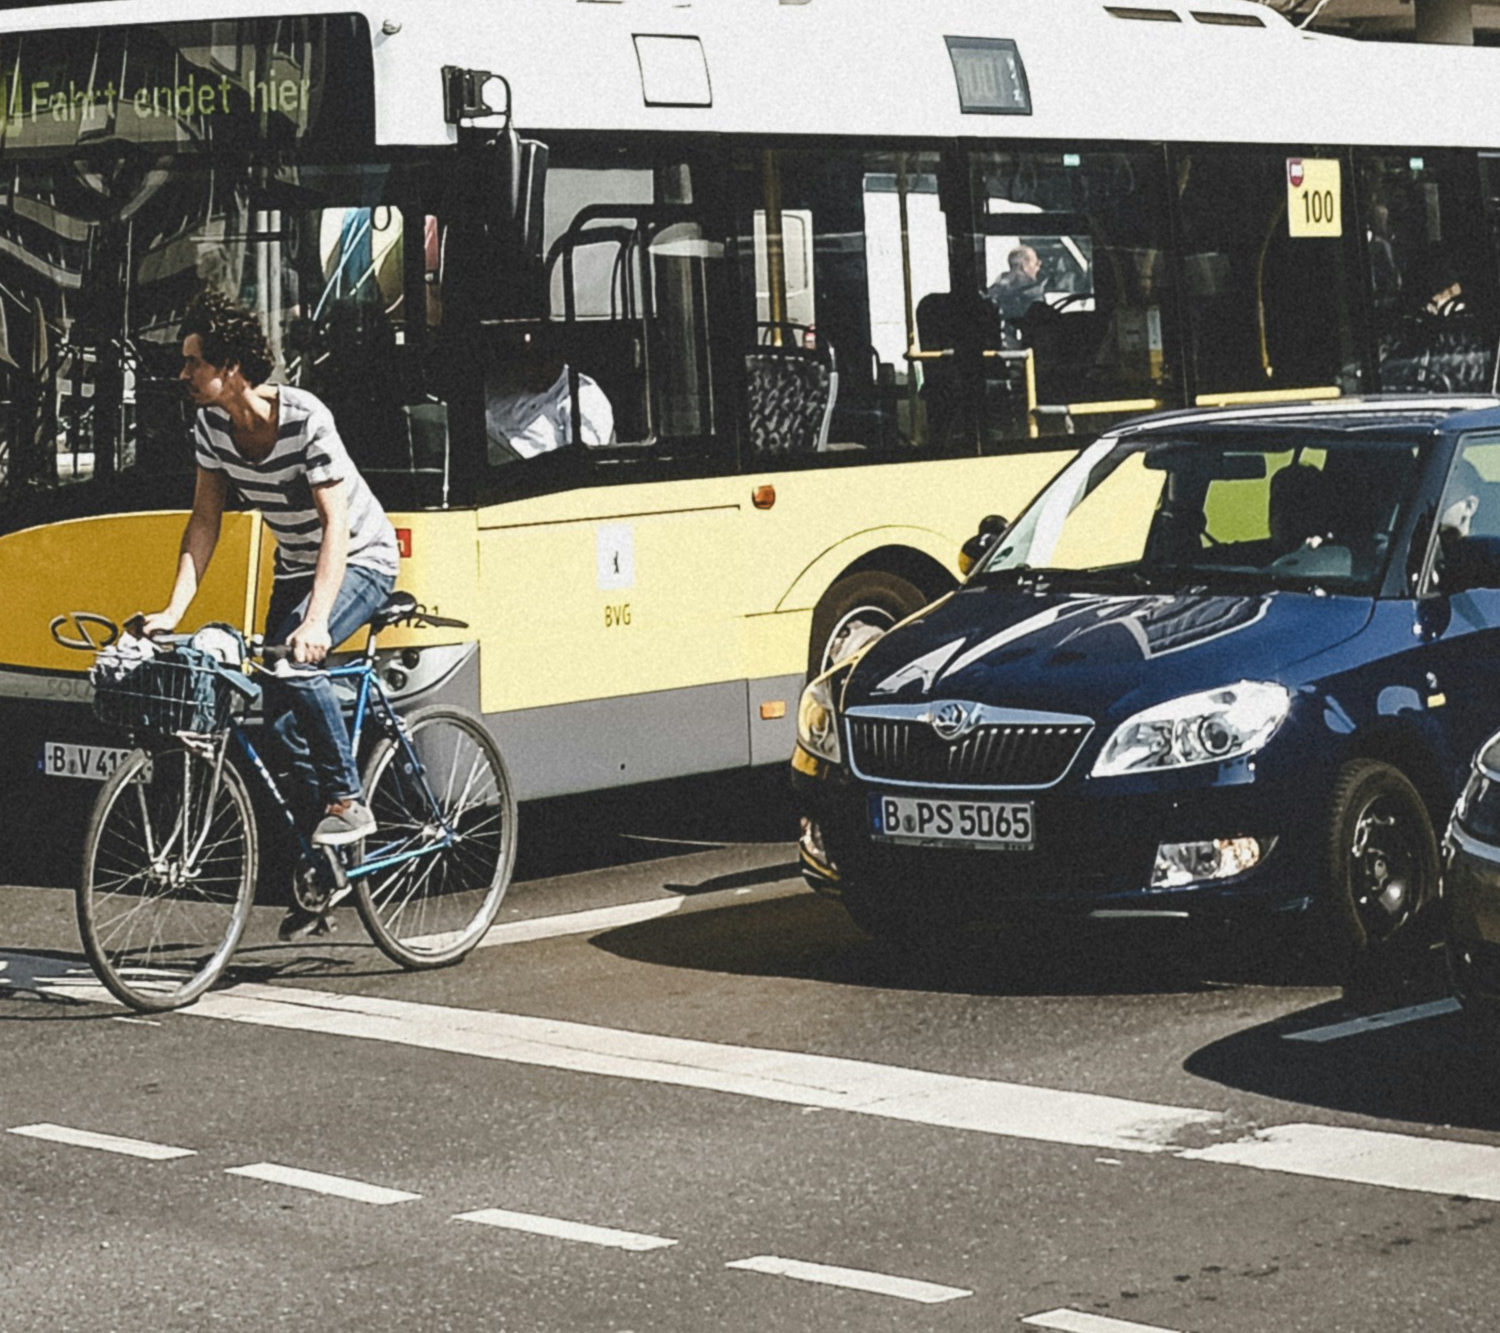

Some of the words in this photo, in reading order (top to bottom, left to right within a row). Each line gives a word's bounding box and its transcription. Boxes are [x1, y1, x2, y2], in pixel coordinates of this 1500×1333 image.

[133, 73, 230, 119] endet
[1302, 190, 1334, 223] 100
[604, 603, 631, 628] BVG
[53, 745, 66, 773] B
[78, 747, 91, 775] V
[884, 799, 900, 832] B
[916, 802, 954, 835] PS
[958, 804, 1030, 839] 5065
